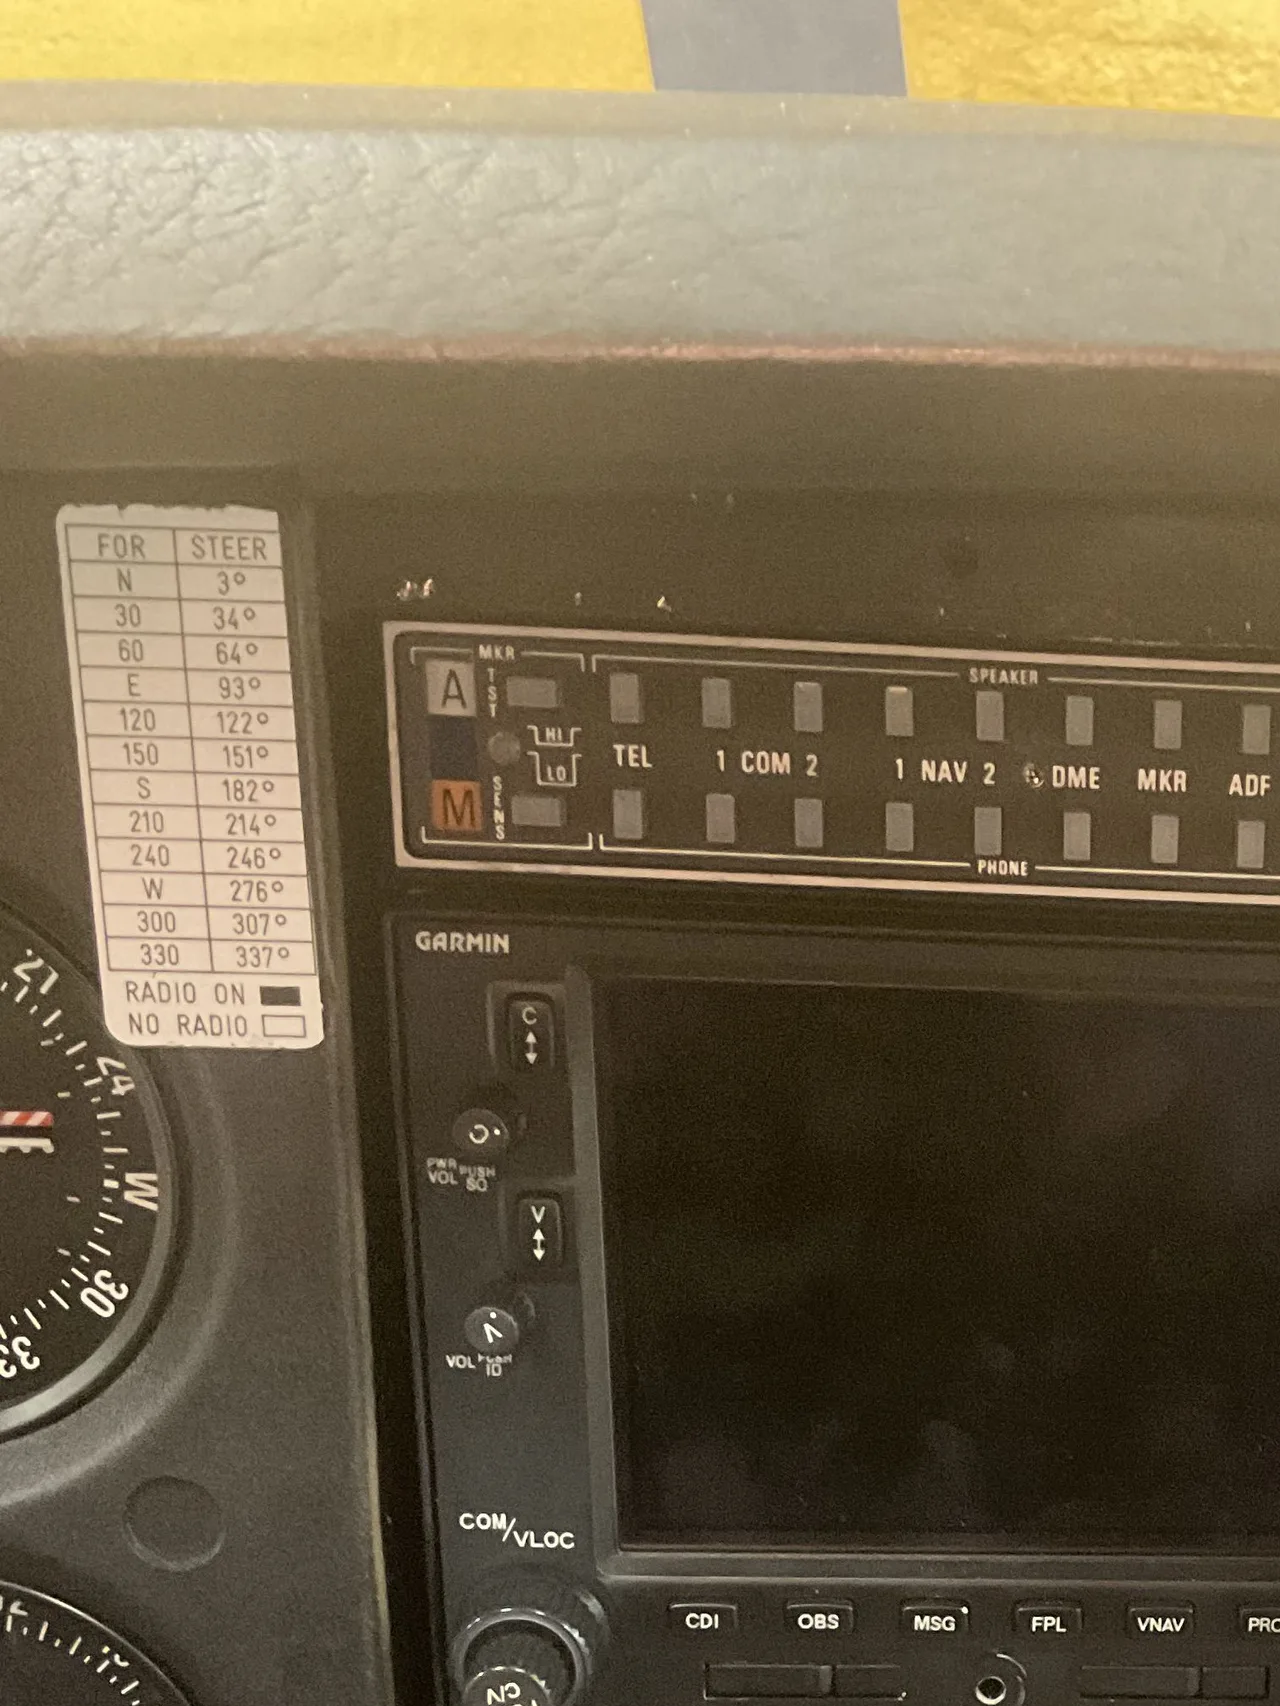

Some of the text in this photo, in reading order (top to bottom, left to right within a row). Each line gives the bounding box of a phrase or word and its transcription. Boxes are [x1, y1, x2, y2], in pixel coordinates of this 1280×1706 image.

[97, 533, 146, 560] FOR
[192, 535, 268, 561] STEER
[117, 569, 132, 592] N
[217, 571, 245, 595] 3°
[115, 604, 141, 628] 30
[213, 608, 255, 631] 34°
[118, 639, 143, 662] 60
[216, 643, 258, 666] 64°
[479, 644, 515, 660] MKR
[127, 673, 140, 697] E
[218, 676, 261, 699] 93°
[969, 668, 1038, 685] SPEAKER
[441, 669, 468, 709] A
[120, 707, 155, 731] 120
[217, 711, 269, 735] 122°
[122, 742, 159, 765] 150
[222, 745, 269, 769] 151°
[613, 744, 653, 769] TEL
[741, 751, 818, 776] COM 2
[921, 759, 996, 785] NAV 2
[1052, 766, 1100, 790] DME
[1137, 768, 1187, 792] MKR
[138, 777, 151, 800] S
[222, 780, 275, 803] 182°
[1229, 774, 1271, 797] ADF
[442, 788, 476, 829] M
[129, 811, 164, 834] 210
[225, 814, 277, 837] 214°
[131, 844, 170, 867] 240
[227, 847, 281, 870] 246°
[978, 860, 1028, 876] PHONE
[142, 877, 164, 899] W
[230, 880, 284, 902] 276°
[137, 910, 176, 933] 300
[232, 914, 287, 936] 307°
[415, 930, 511, 955] GARMIN
[141, 944, 180, 966] 330
[236, 948, 289, 968] 337°
[125, 981, 245, 1005] RADIO ON
[128, 1013, 249, 1037] NO RADIO
[522, 1007, 537, 1025] C
[123, 1173, 159, 1211] W
[531, 1205, 546, 1224] V
[81, 1269, 129, 1318] 30
[446, 1354, 476, 1370] VOL
[685, 1613, 719, 1630] CDI
[797, 1613, 840, 1631] OBS
[913, 1615, 956, 1632] MSG
[1031, 1617, 1066, 1633] FPL
[1137, 1616, 1185, 1633] VNAV
